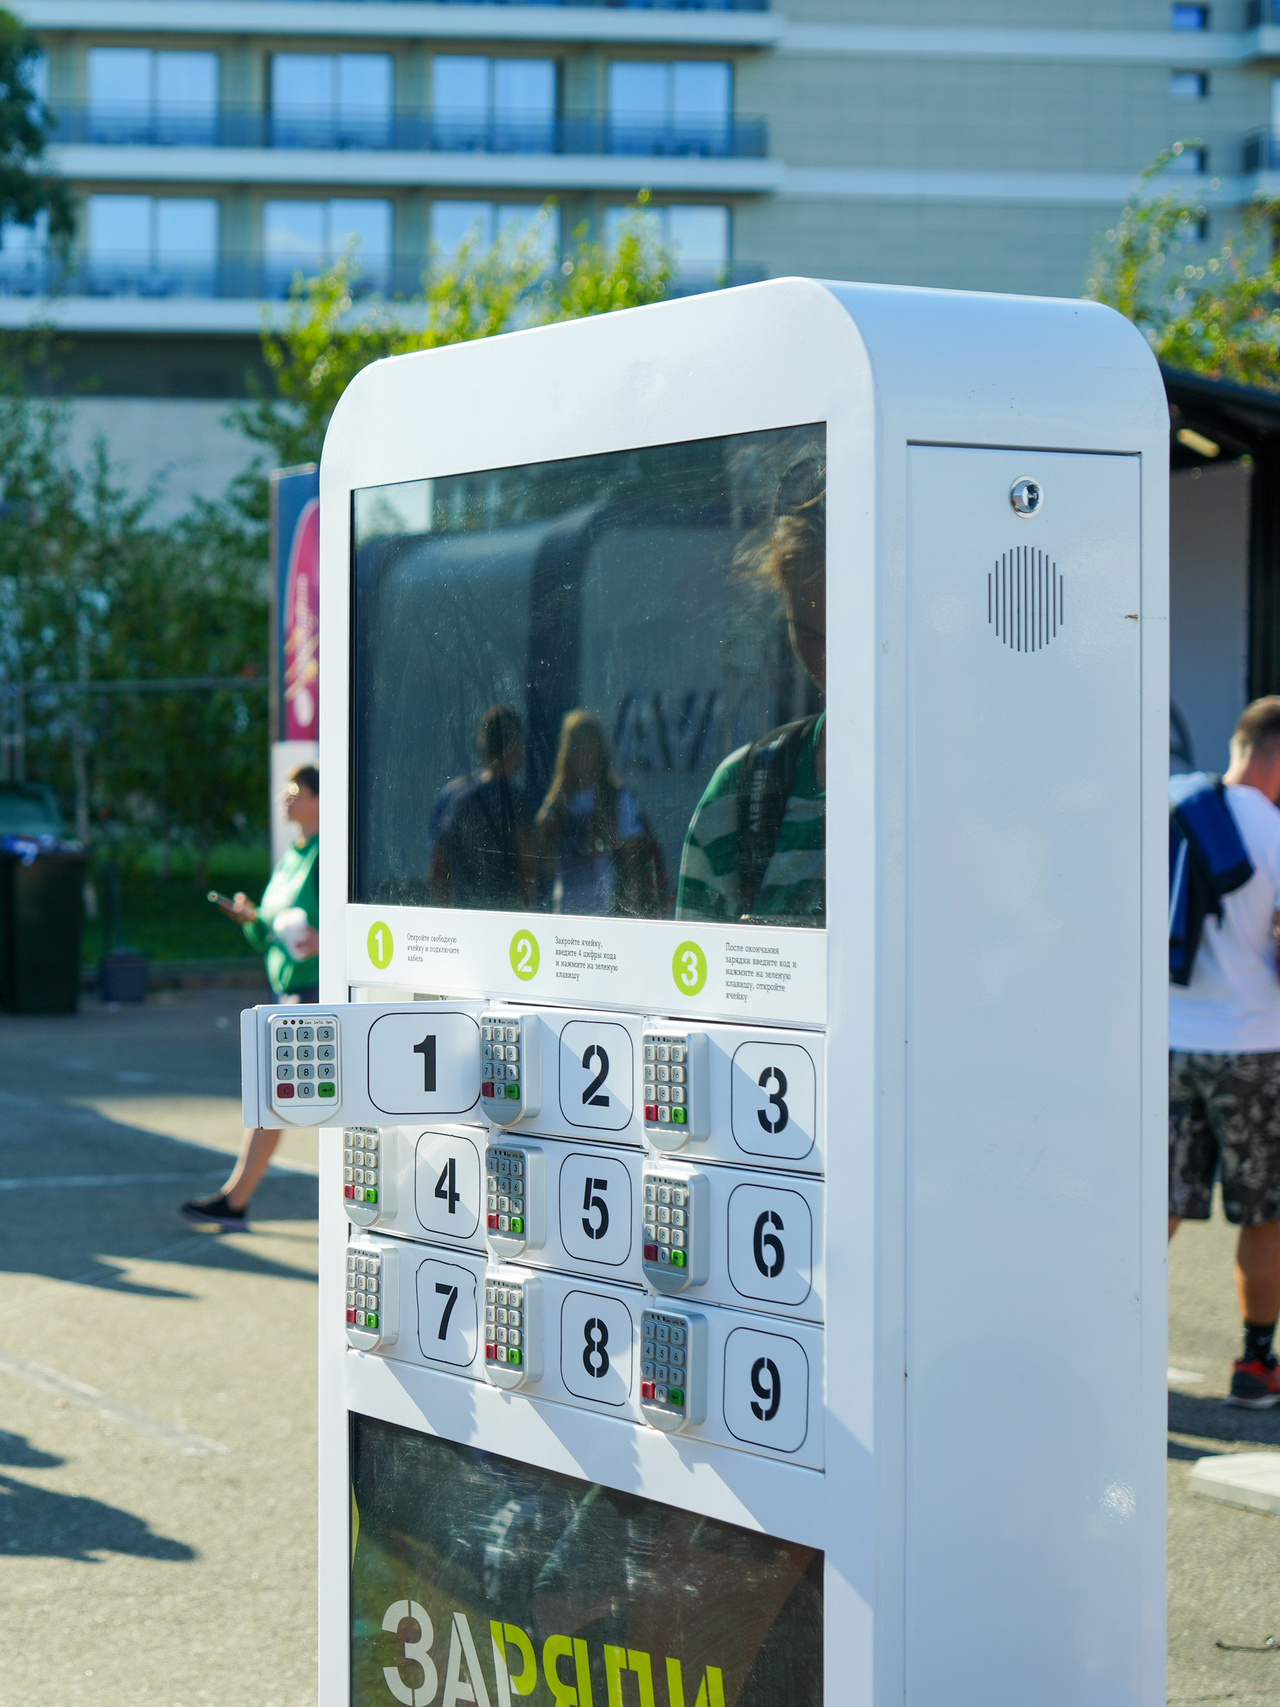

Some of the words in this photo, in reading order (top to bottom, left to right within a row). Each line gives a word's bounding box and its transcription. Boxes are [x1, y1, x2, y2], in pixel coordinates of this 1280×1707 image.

[375, 929, 383, 961] 1
[407, 933, 429, 943] Откройте
[555, 936, 580, 948] Закройте
[555, 949, 576, 957] введите
[583, 950, 602, 960] цифры
[725, 942, 743, 952] После
[745, 946, 779, 955] окончания
[517, 938, 532, 972] 2
[561, 961, 586, 969] нажмите
[681, 950, 699, 987] 3
[725, 956, 750, 966] зарядки
[752, 959, 777, 967] введите
[555, 971, 580, 982] клавишу
[725, 968, 754, 978] нажмите
[764, 972, 791, 982] зеленую
[725, 980, 754, 992] клавишу,
[756, 983, 785, 993] откройте
[725, 992, 748, 1003] ячейку
[414, 1035, 436, 1092] 1
[582, 1044, 609, 1106] 2
[758, 1066, 788, 1133] 3
[435, 1158, 460, 1213] 4
[582, 1178, 609, 1239] 5
[753, 1210, 784, 1278] 6
[435, 1283, 458, 1340] 7
[583, 1317, 608, 1378] 8
[750, 1357, 781, 1421] 9
